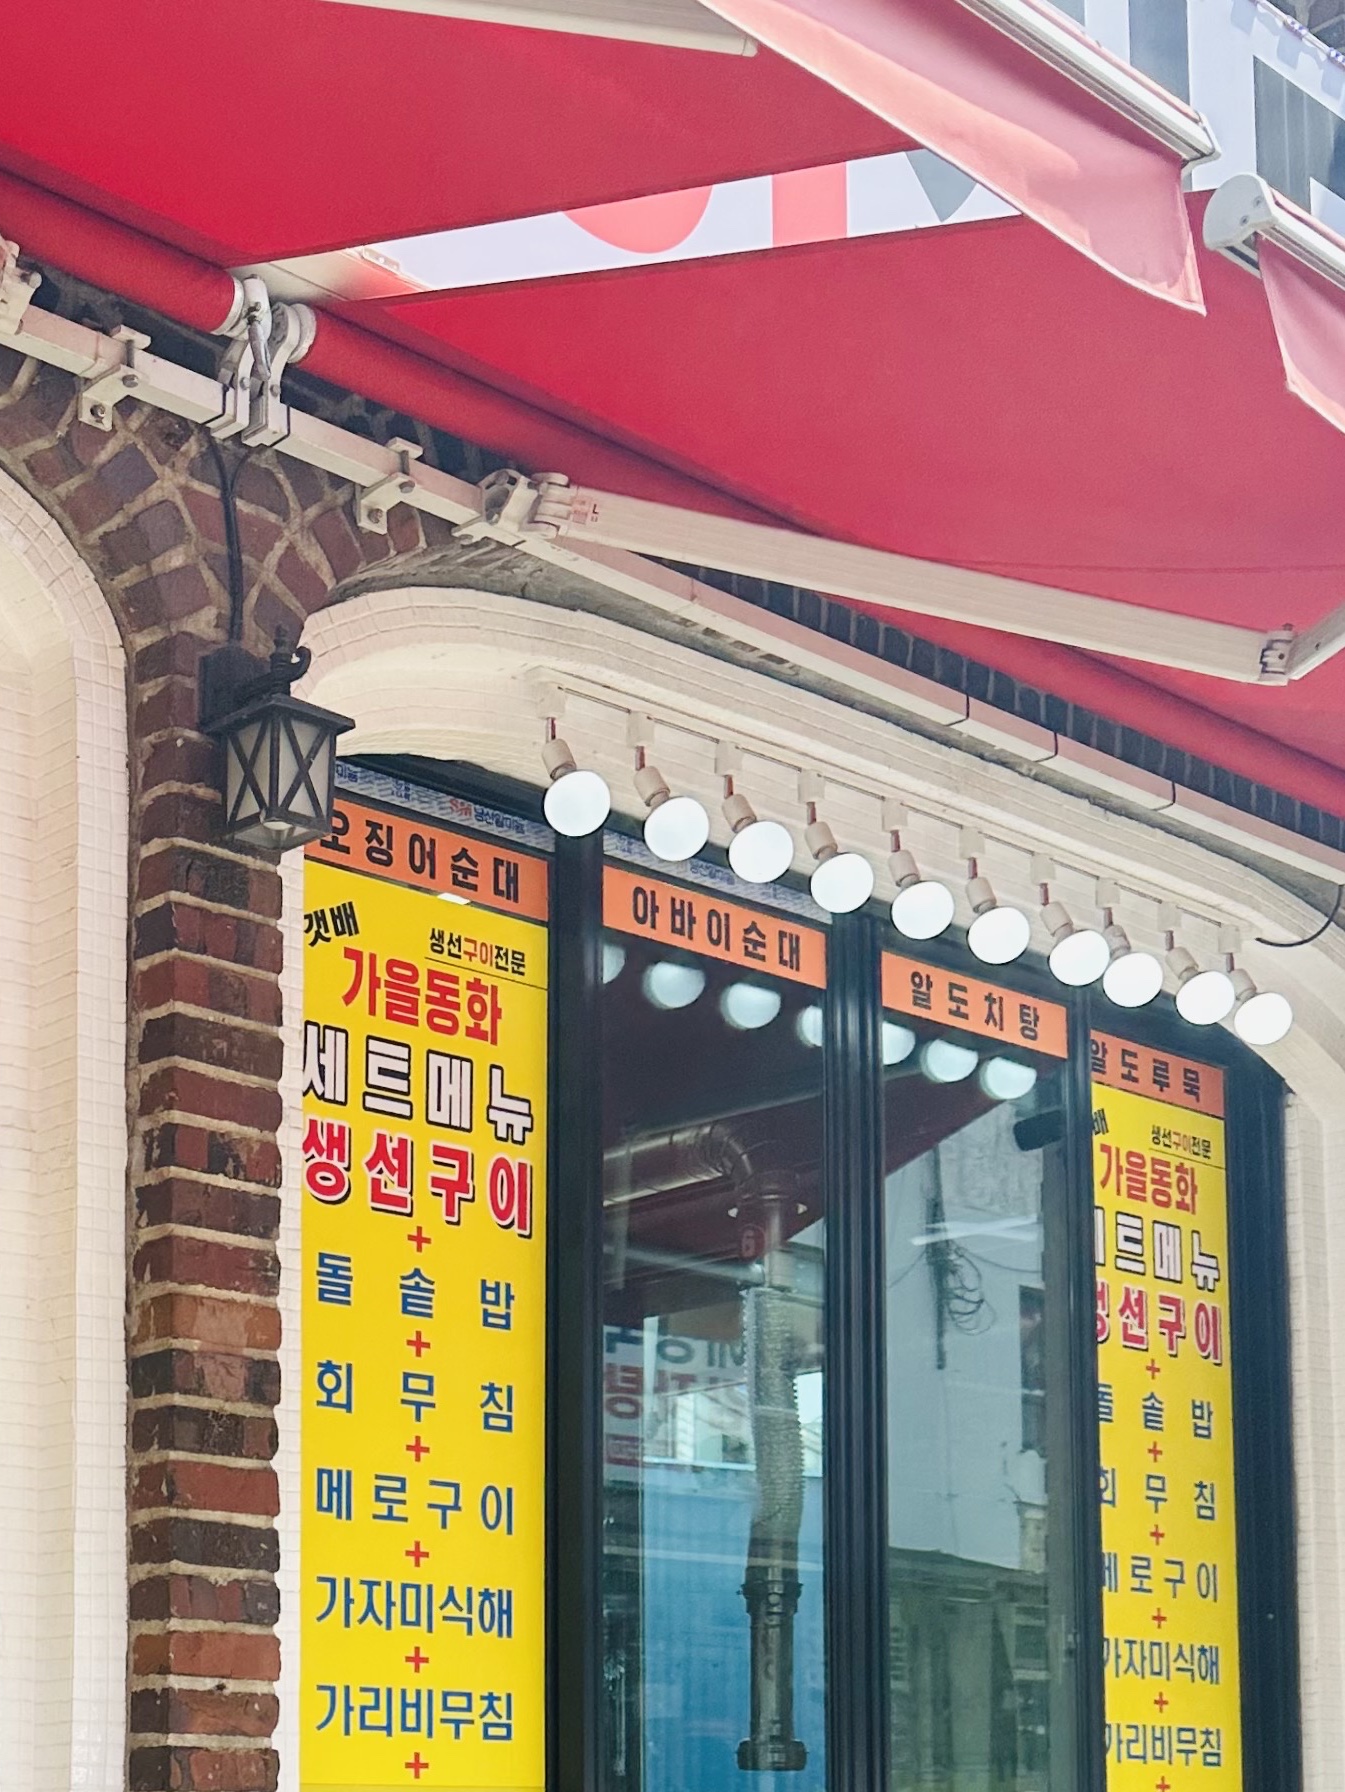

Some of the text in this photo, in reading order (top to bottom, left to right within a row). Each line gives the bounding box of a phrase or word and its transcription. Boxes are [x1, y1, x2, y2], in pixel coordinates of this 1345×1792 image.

[304, 899, 361, 947] 갯배
[428, 926, 527, 977] 생선구이전문
[342, 945, 503, 1047] 가을동화
[302, 1020, 534, 1147] 세트메뉴
[1151, 1124, 1212, 1160] 생선구이전문
[302, 1115, 533, 1240] 생선구이
[1099, 1142, 1199, 1215] 가을동화
[315, 1575, 514, 1639] 가자미식해
[315, 1683, 514, 1742] 가리비무침
